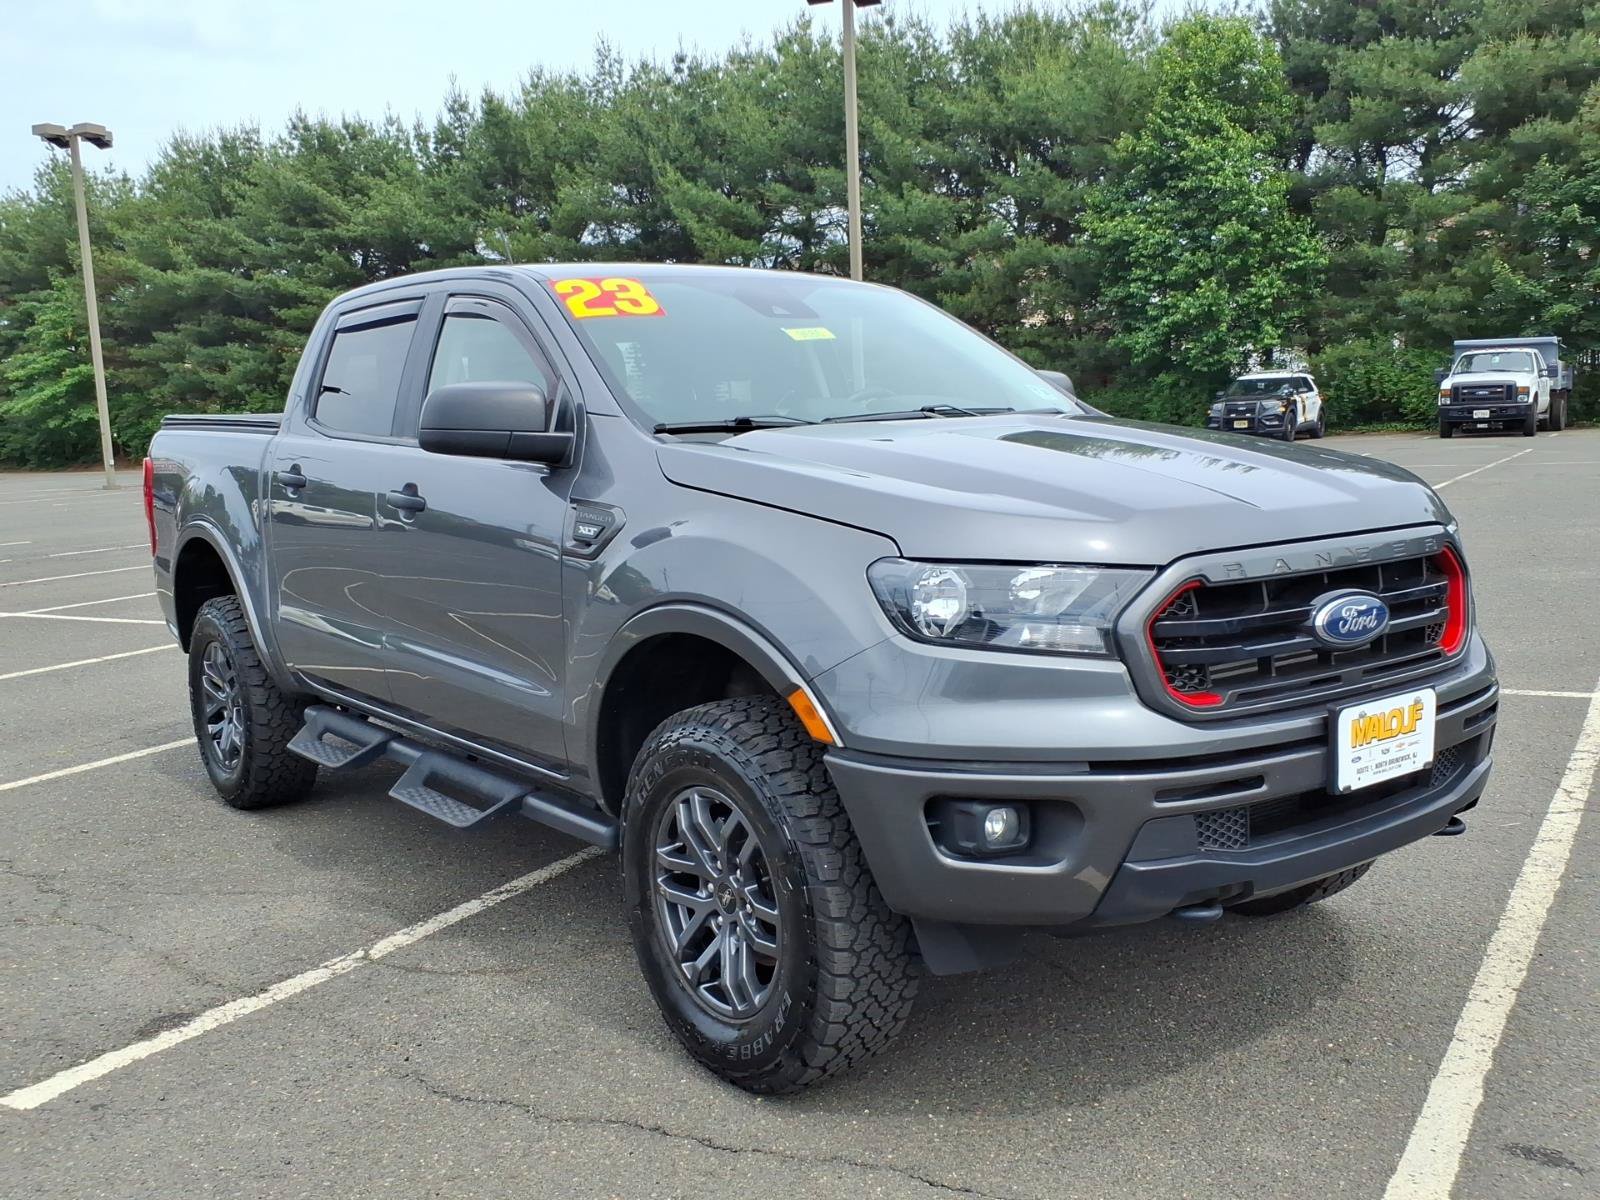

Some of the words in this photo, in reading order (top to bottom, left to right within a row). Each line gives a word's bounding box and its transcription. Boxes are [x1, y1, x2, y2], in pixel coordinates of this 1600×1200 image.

[554, 278, 659, 318] 23
[578, 525, 598, 536] XLT
[1338, 604, 1379, 634] Ford
[1350, 702, 1424, 749] MALOUF
